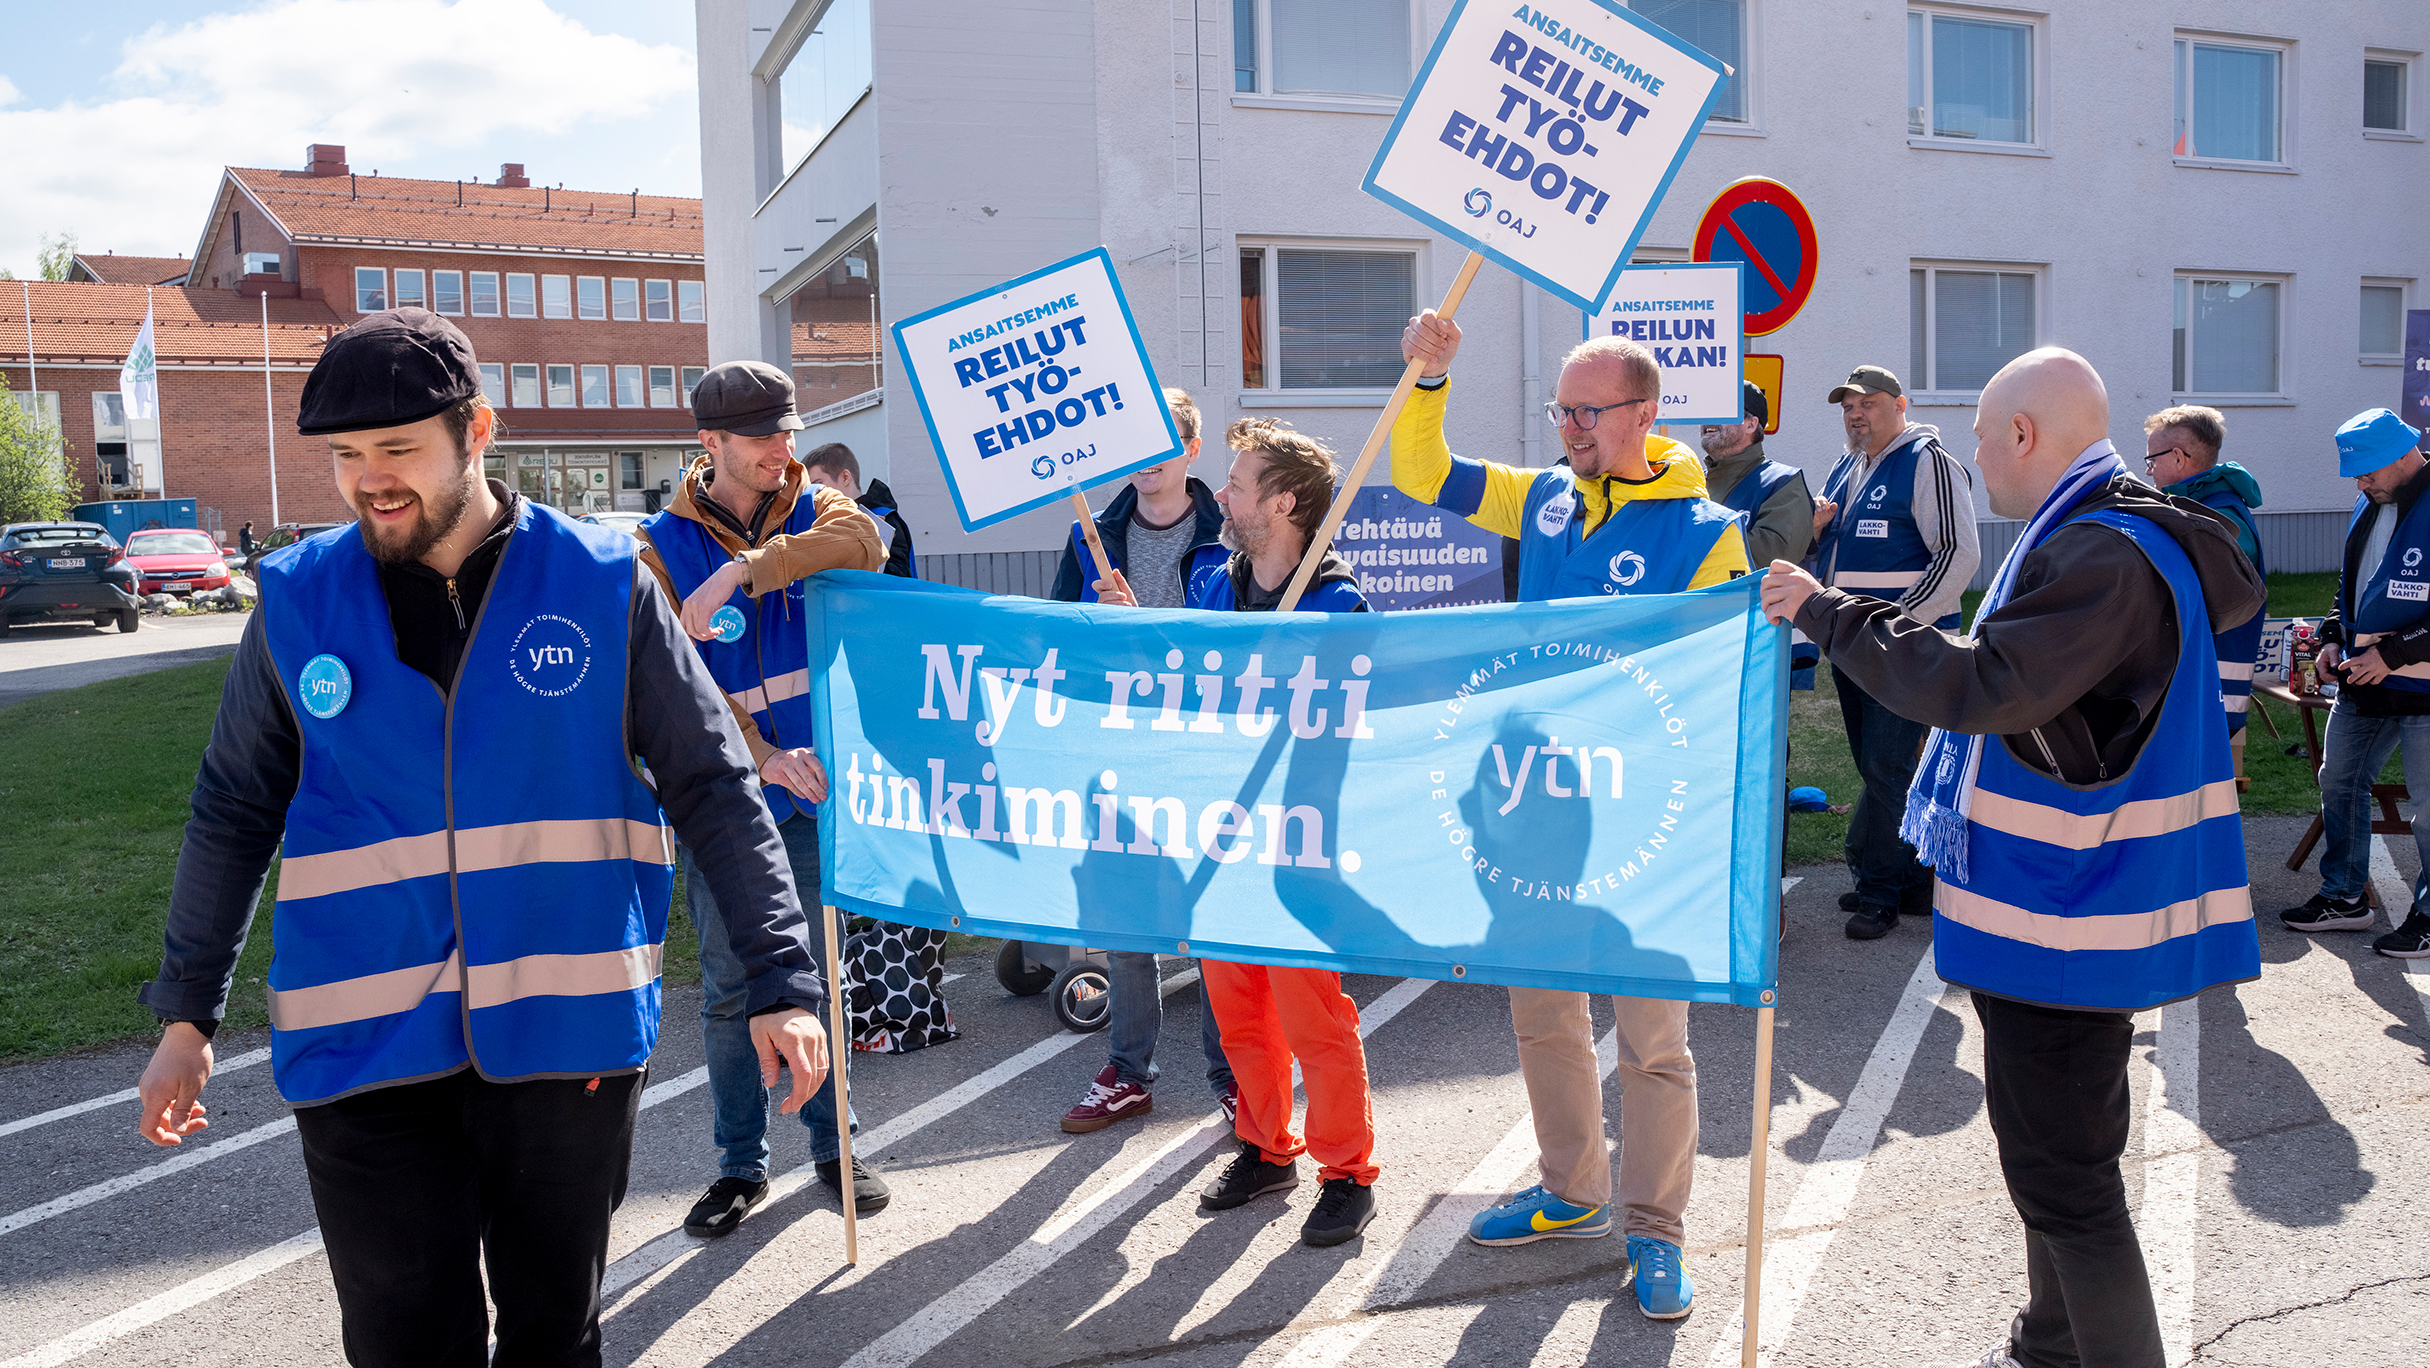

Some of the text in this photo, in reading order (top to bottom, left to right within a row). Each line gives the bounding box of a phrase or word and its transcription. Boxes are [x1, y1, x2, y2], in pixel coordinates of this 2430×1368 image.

[1512, 4, 1665, 97] ANSAITSEMME
[1489, 29, 1650, 136] REILUT
[1495, 83, 1599, 158] TYÖ-
[1438, 110, 1610, 225] EHDOT!
[1496, 209, 1537, 239] OAJ
[948, 293, 1079, 353] ANSAITSEMME
[1612, 300, 1715, 312] ANSAITSEMME
[1612, 319, 1715, 340] REILUN
[953, 315, 1087, 388] REILUT
[1652, 346, 1726, 367] KAN!
[985, 357, 1082, 413] TYÖ-
[1662, 395, 1687, 404] OAJ
[972, 382, 1124, 460] EHDOT!
[1061, 443, 1097, 466] OAJ
[1543, 513, 1564, 526] VAHTI
[1545, 504, 1569, 516] LAKKO-
[1333, 516, 1442, 540] Tehtävä
[1338, 543, 1487, 566] vaisuuden
[1358, 570, 1453, 594] koinen
[2391, 590, 2418, 598] VAHTI
[2392, 582, 2427, 591] LAKKO-
[510, 614, 591, 652] YLEMMÄT TOIMIHENKILÖT
[529, 645, 574, 672] ytn
[312, 679, 336, 696] ytn
[509, 656, 591, 696] DE HÖGRE TJÄNSTEMÄNNEN
[918, 643, 1375, 747] Nyt riitti
[1434, 643, 1688, 749] YLEMMÄT TOIMIHENKILÖT
[1491, 736, 1623, 817] ytn
[846, 751, 1362, 874] tinkiminen.
[1430, 770, 1688, 900] DE HÖGRE TJÄNSTEMÄNNEN
